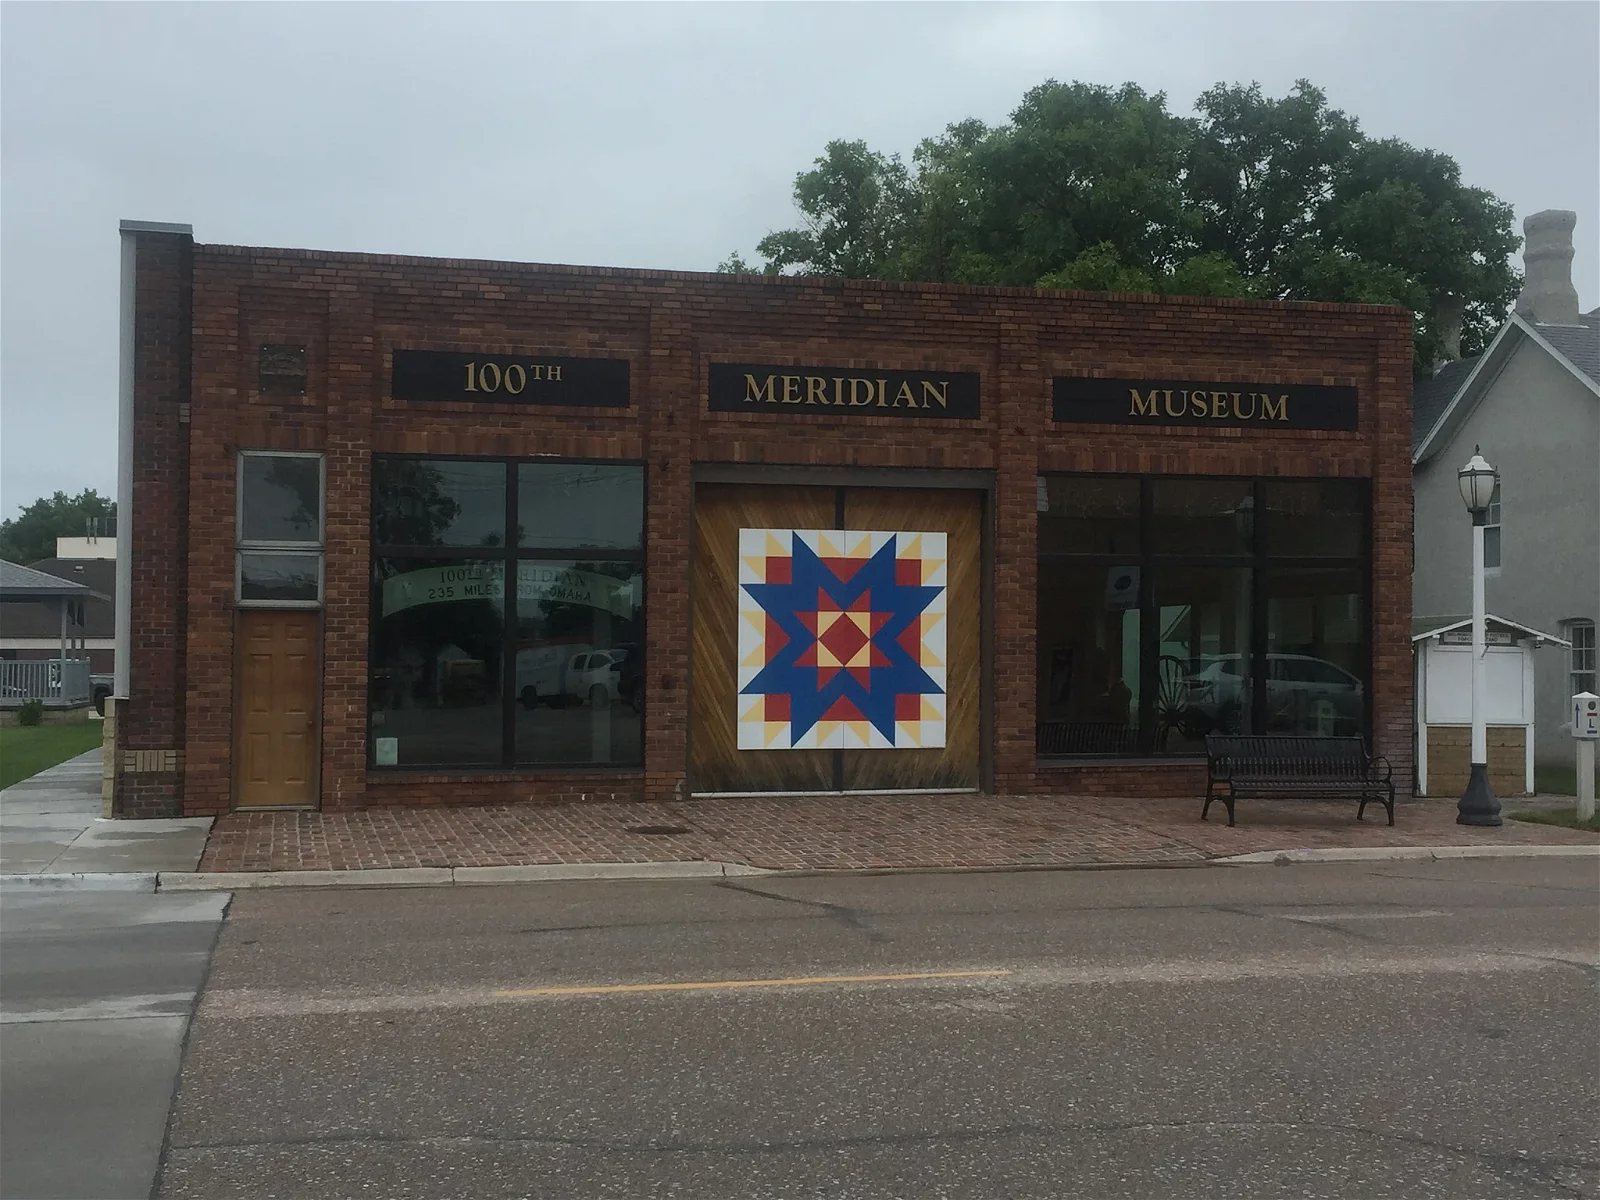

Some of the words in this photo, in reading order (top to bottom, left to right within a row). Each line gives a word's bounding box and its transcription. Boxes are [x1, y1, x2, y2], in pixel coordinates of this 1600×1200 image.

[464, 362, 562, 394] 100TH
[744, 374, 949, 409] MERIDIAN
[1128, 389, 1289, 421] MUSEUM
[440, 568, 483, 583] 100TH
[428, 587, 454, 599] 235
[464, 584, 500, 596] MILES
[518, 585, 541, 595] ROM
[550, 587, 592, 602] OMAHA
[1588, 718, 1595, 729] L
